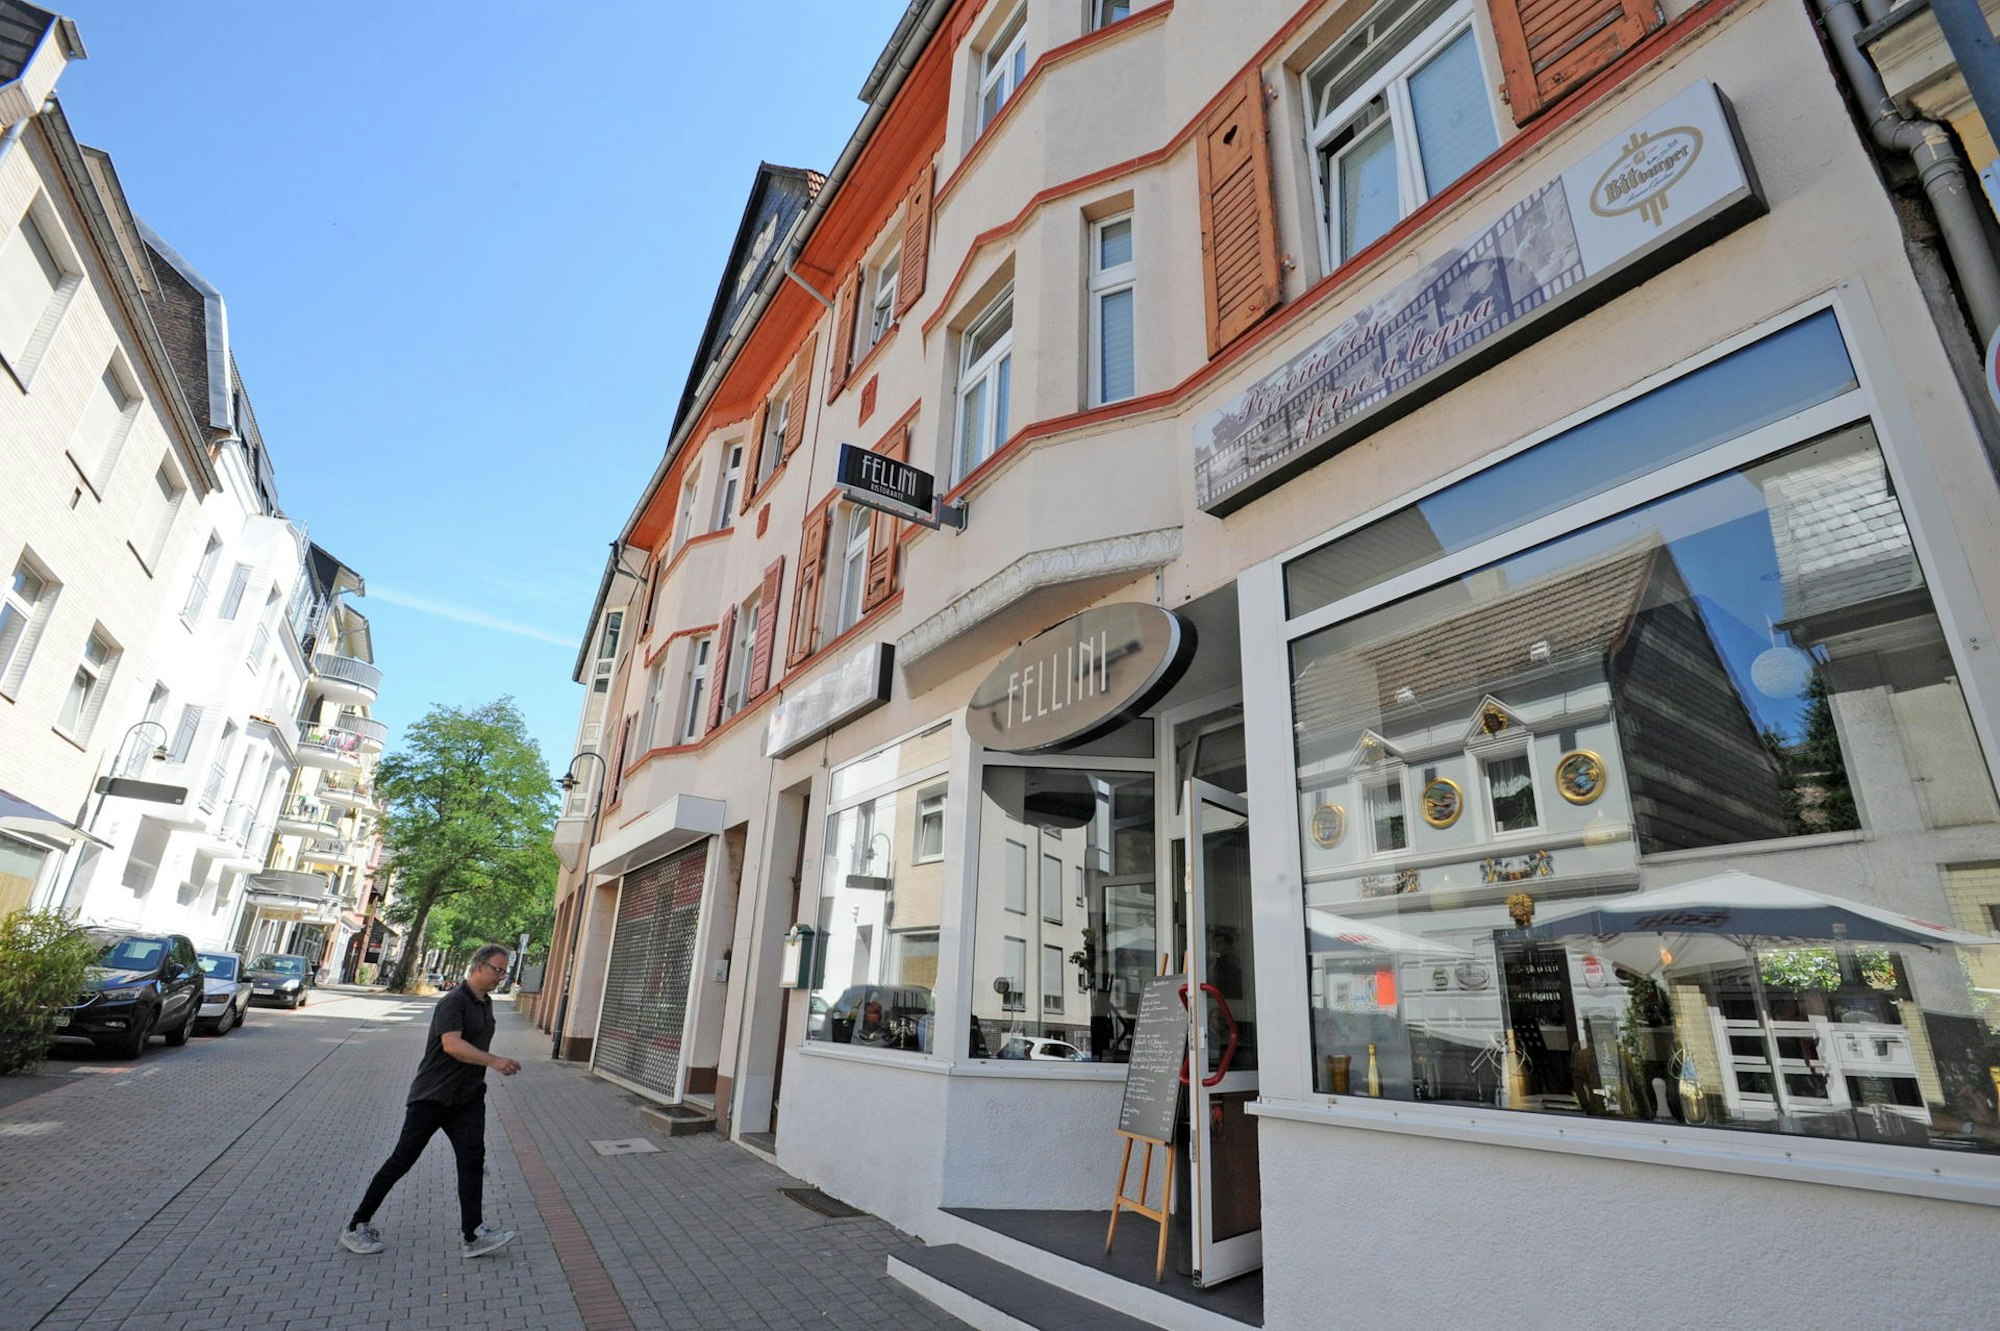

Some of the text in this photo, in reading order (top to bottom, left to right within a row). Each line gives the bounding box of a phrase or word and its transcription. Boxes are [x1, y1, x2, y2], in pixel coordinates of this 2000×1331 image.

[1604, 144, 1689, 206] Bitburger
[1238, 320, 1382, 423] Pizzeria con
[1305, 296, 1495, 440] forno a legna
[861, 454, 917, 497] FELLINI
[870, 482, 904, 501] RISTORANTE
[1007, 630, 1106, 729] FELLINI
